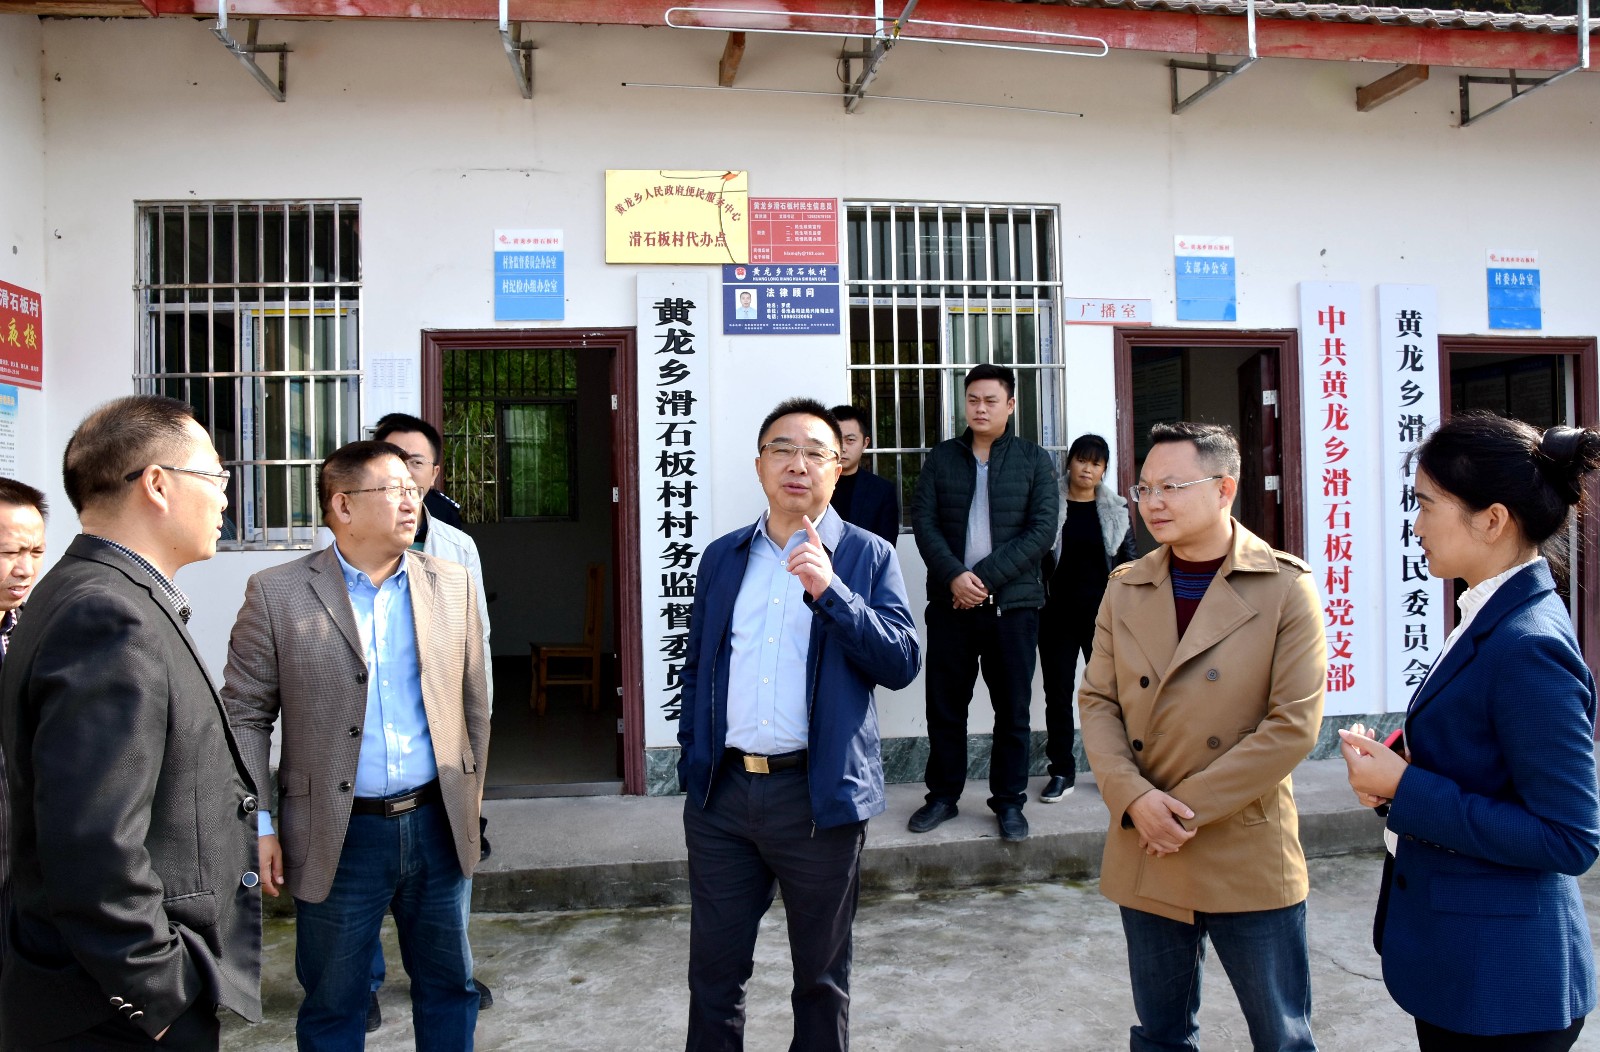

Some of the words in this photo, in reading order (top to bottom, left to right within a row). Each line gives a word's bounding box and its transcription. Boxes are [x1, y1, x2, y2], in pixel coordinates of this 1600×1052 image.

[614, 184, 741, 222] 黄龙乡人民政府便民服务中心
[753, 202, 833, 210] 黄龙乡滑石板村民生信息员
[629, 231, 727, 248] 滑石板村代办点
[503, 255, 557, 270] 村务监督委员会办公室
[1184, 260, 1228, 275] 支部办公室
[752, 267, 827, 276] 黄龙乡滑石板村
[1495, 272, 1534, 286] 村委办公室
[502, 279, 558, 294] 村纪检小组办公室
[766, 287, 815, 298] 法律顾问
[1081, 302, 1137, 319] 广播室
[0, 316, 38, 350] 夜校
[1317, 305, 1356, 693] 中共黄龙乡滑石板村党支部
